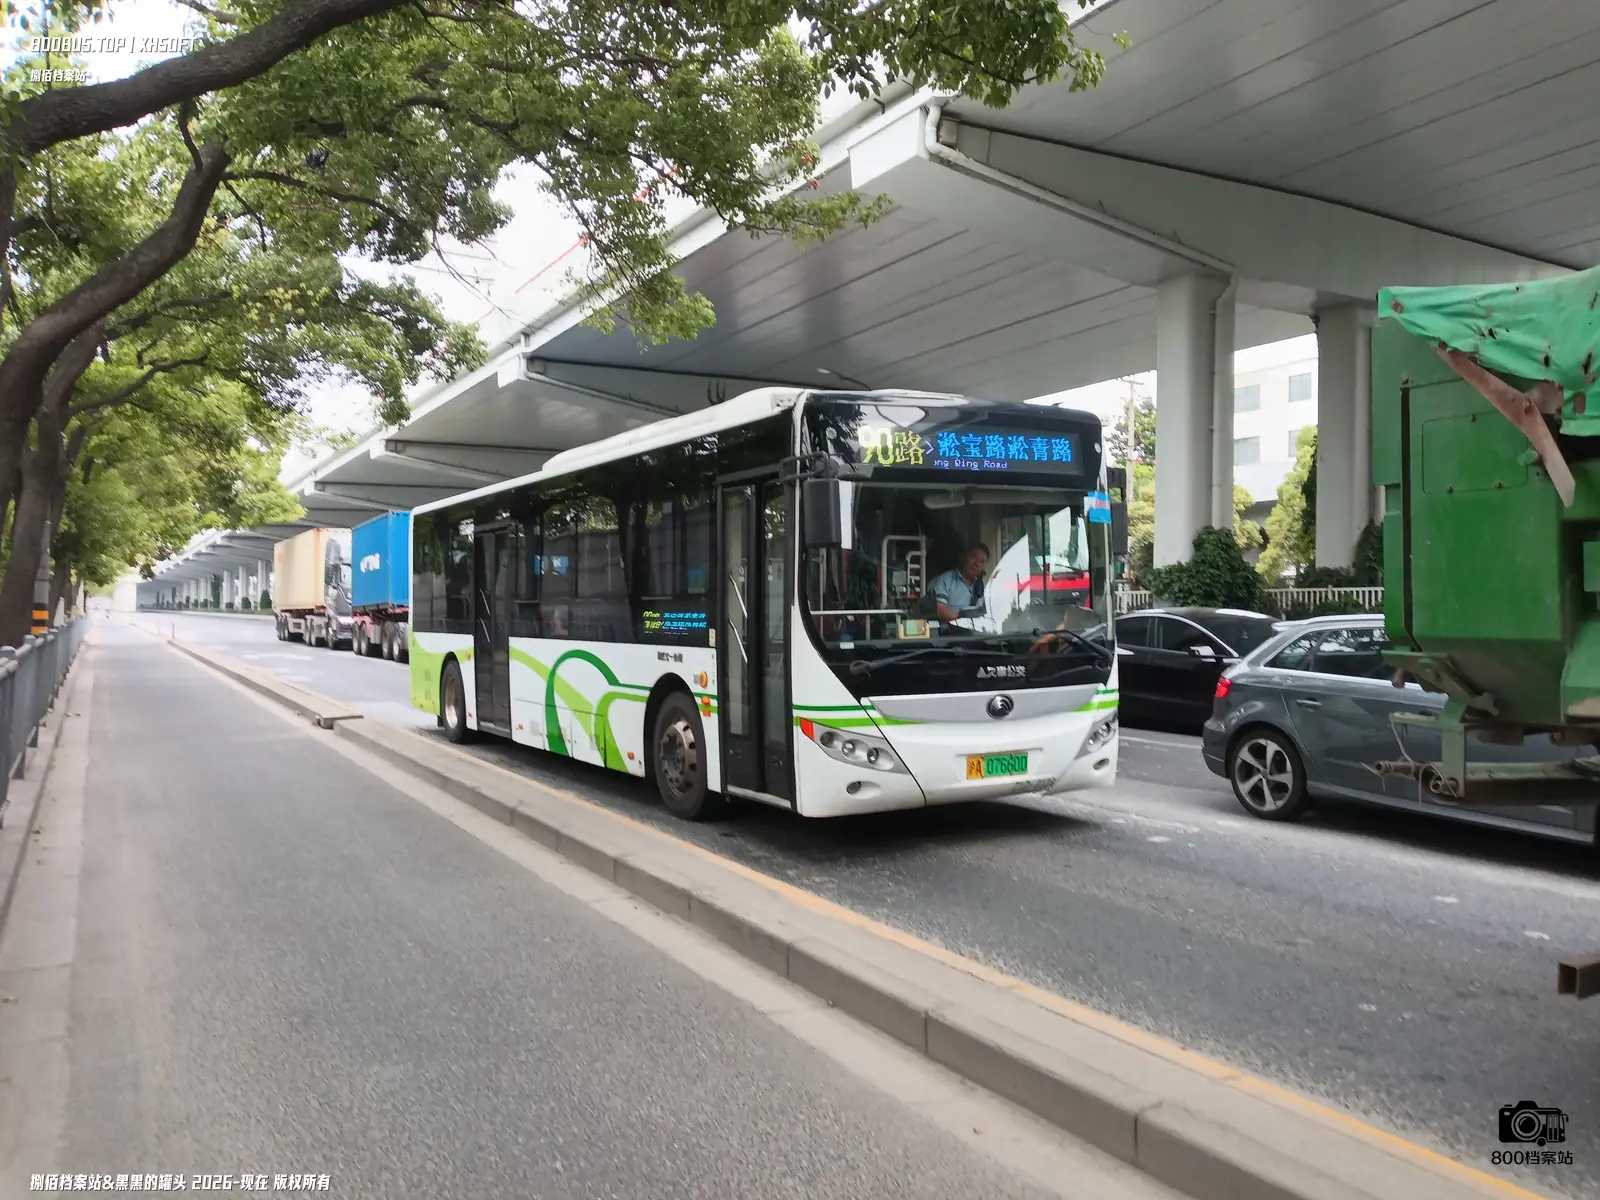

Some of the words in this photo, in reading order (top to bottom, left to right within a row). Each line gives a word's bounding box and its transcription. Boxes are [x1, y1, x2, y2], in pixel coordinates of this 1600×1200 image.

[937, 431, 1072, 462] 淞宝路淞青路
[983, 459, 1008, 469] Road
